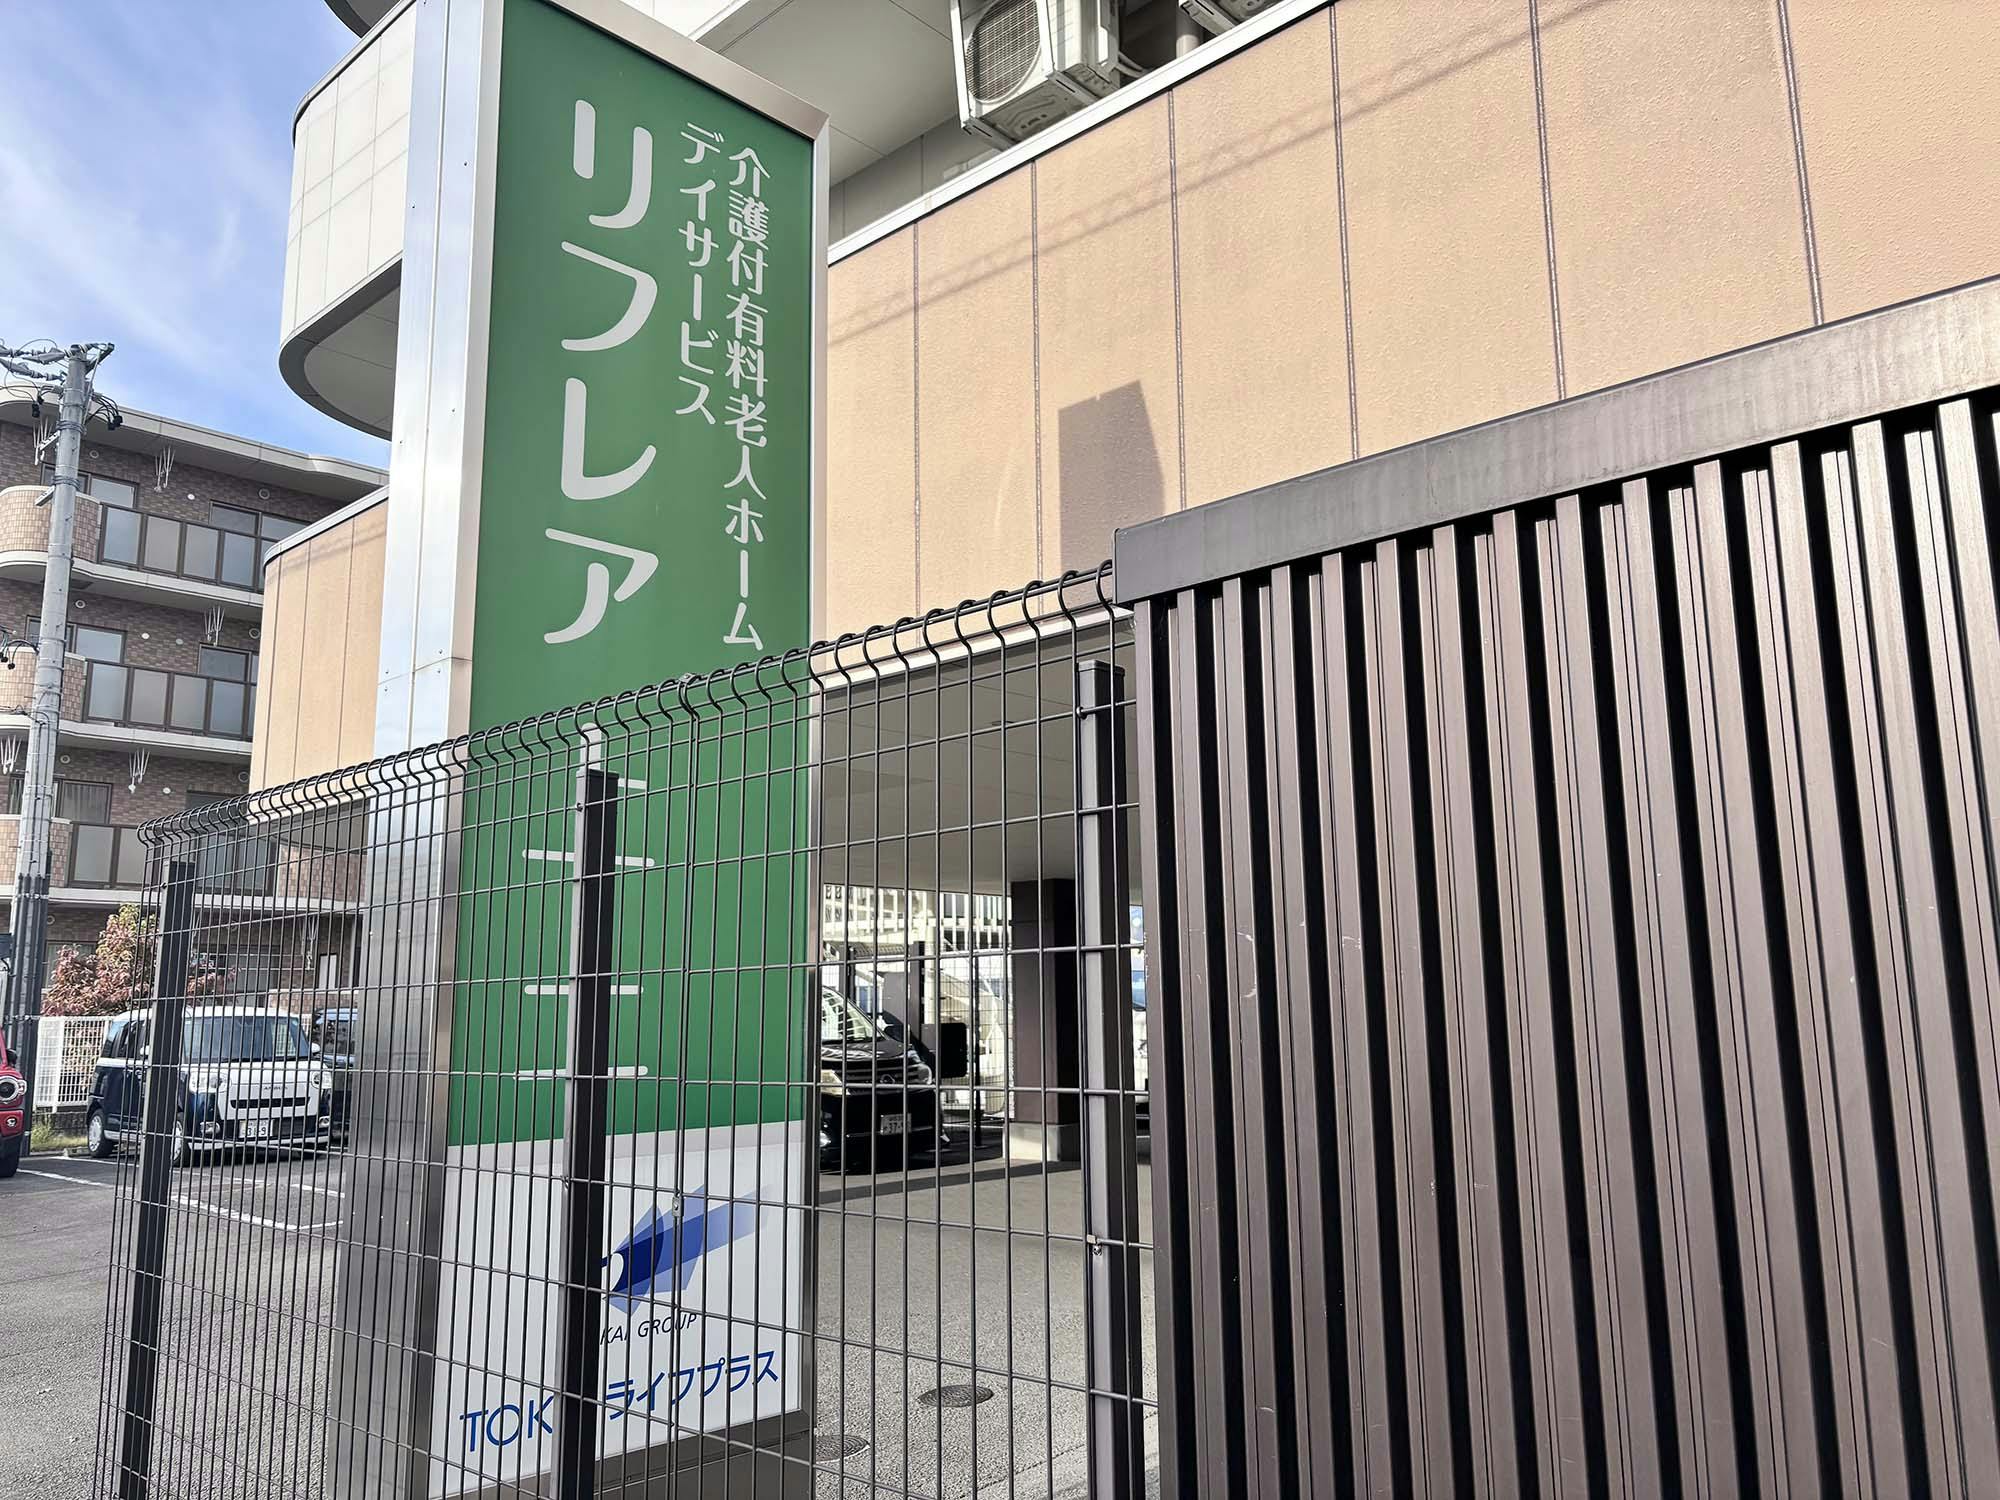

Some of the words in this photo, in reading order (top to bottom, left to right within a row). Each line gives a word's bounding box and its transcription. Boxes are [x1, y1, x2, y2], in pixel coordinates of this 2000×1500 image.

[544, 99, 659, 645] リフレア
[676, 122, 724, 425] デイサービス
[723, 146, 771, 651] 介護付有料老人ホーム
[637, 1312, 697, 1338] GROUP
